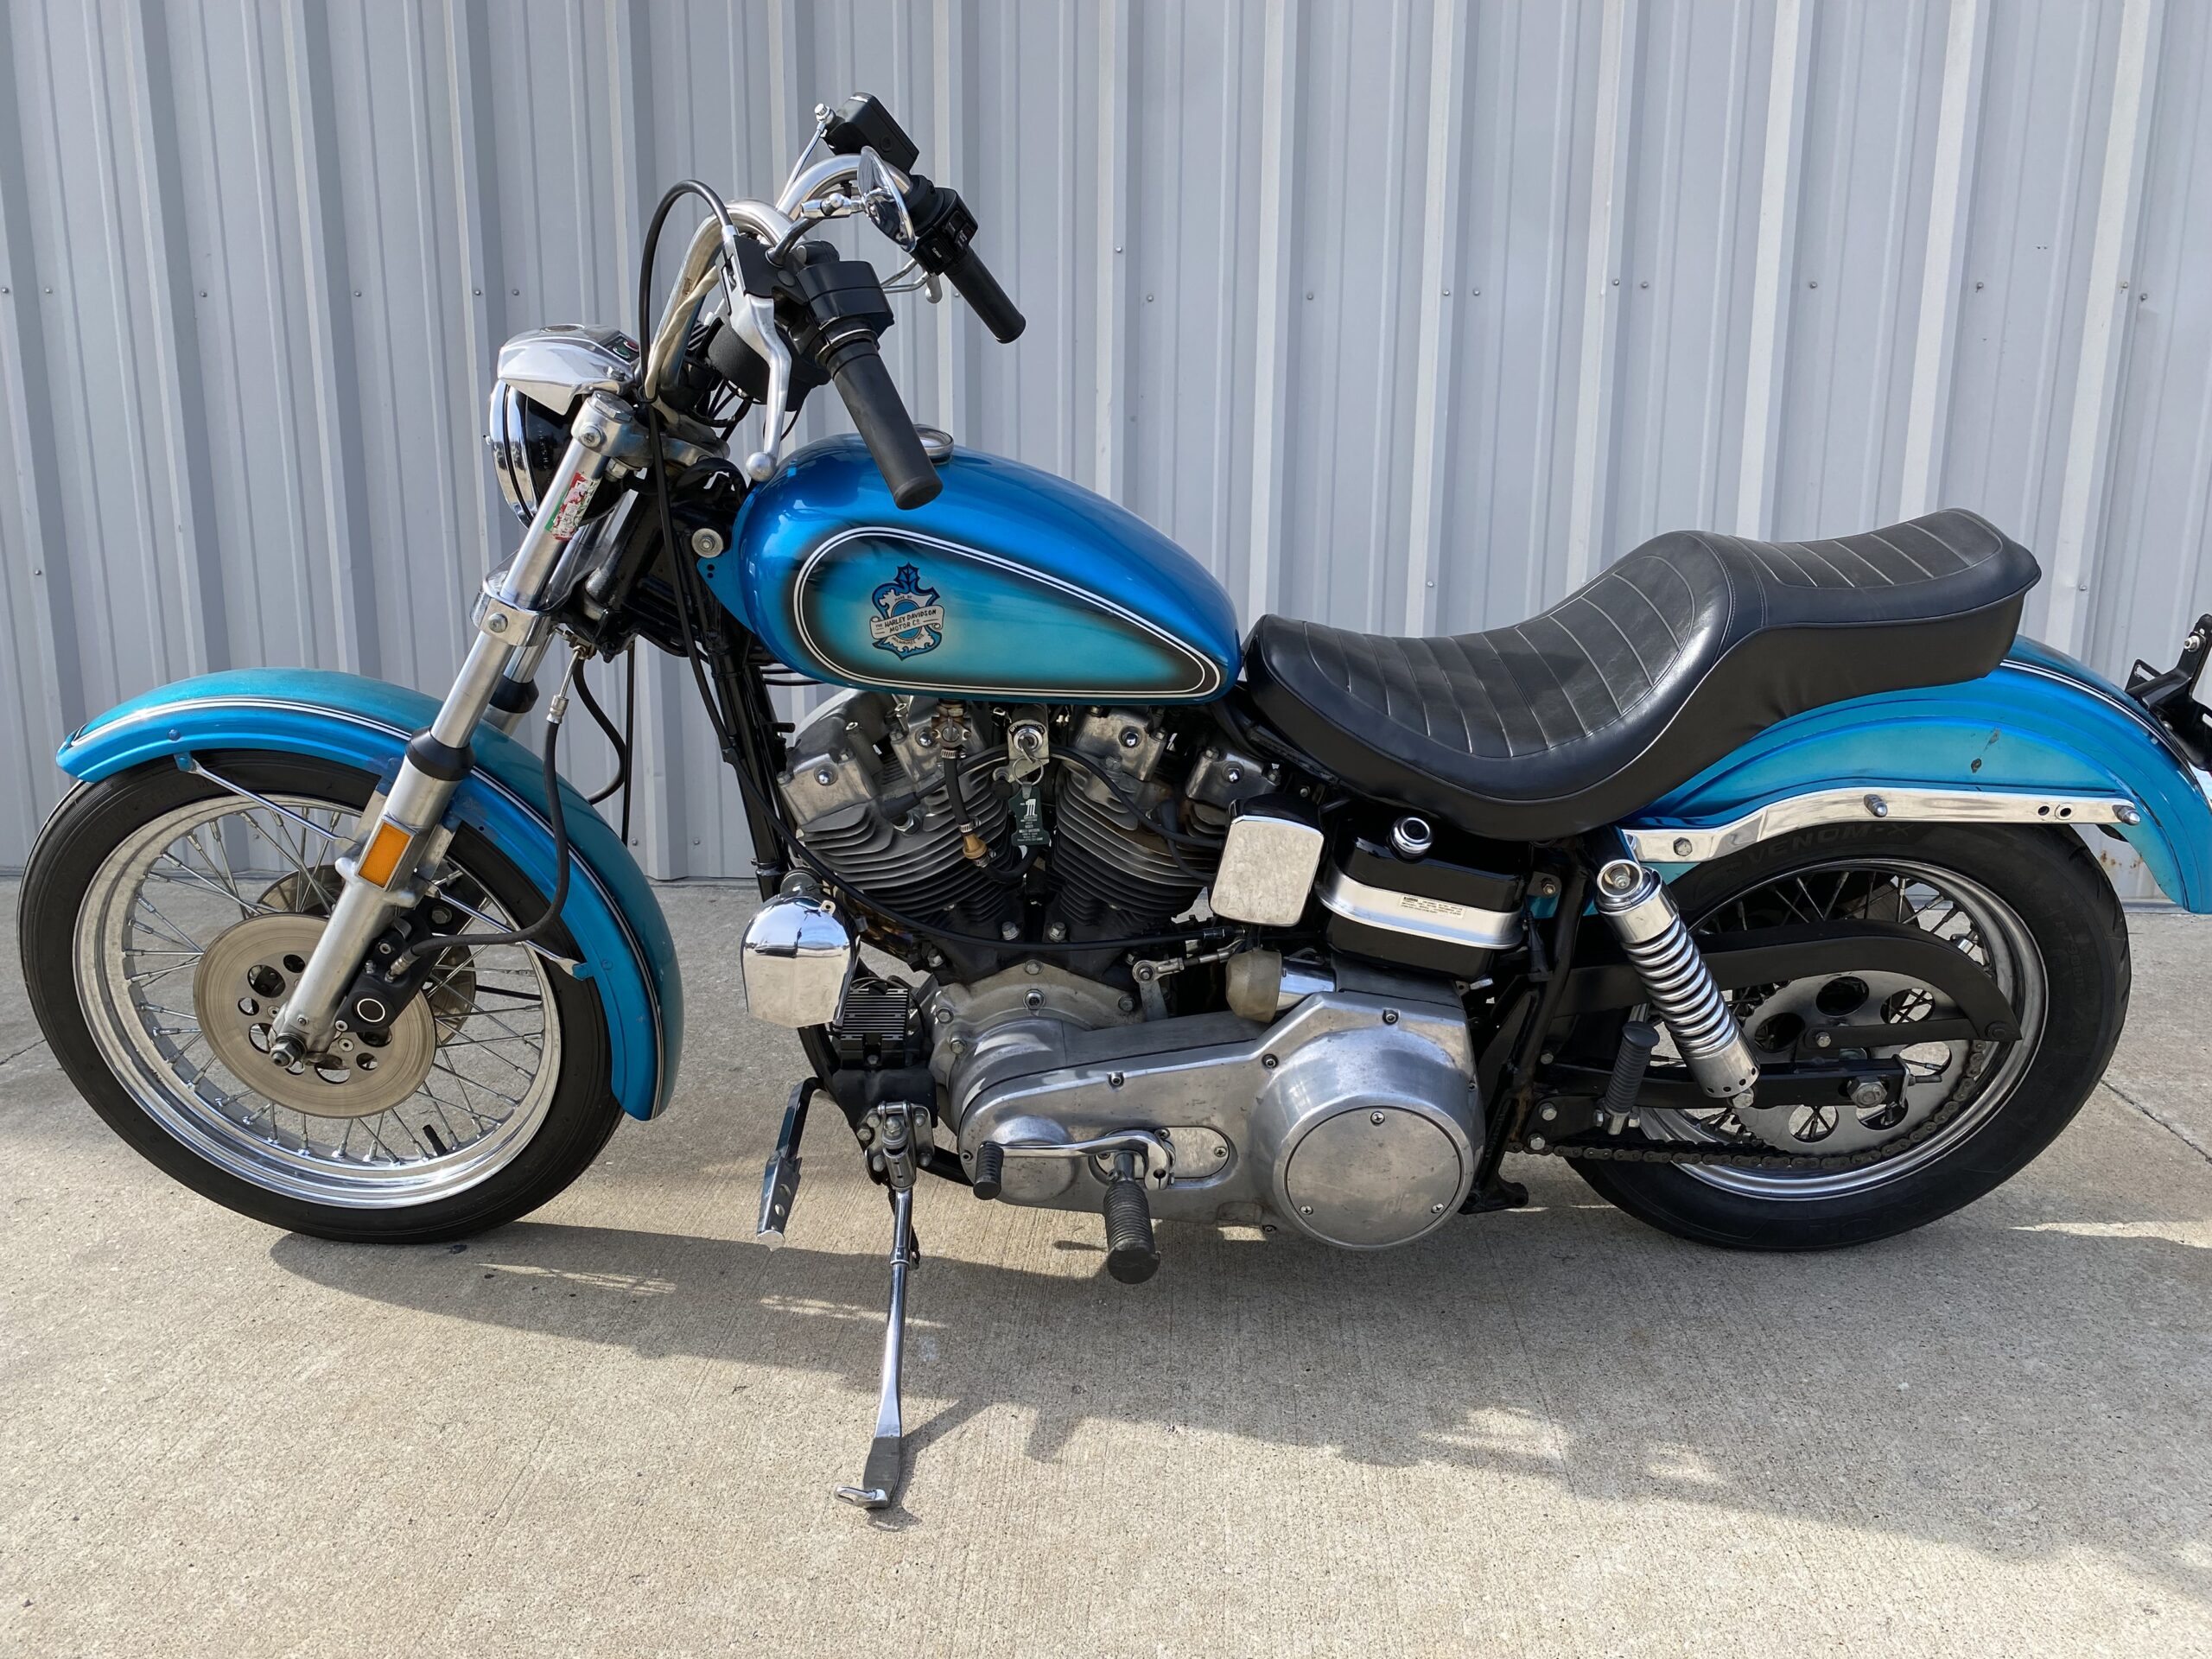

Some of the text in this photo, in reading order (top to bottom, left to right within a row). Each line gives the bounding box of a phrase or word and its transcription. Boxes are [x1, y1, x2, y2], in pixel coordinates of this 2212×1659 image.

[884, 616, 906, 628] HARLEY
[906, 609, 937, 620] DAVIDSON
[889, 622, 911, 633] MOTOR
[1747, 823, 1915, 865] VENOM-X
